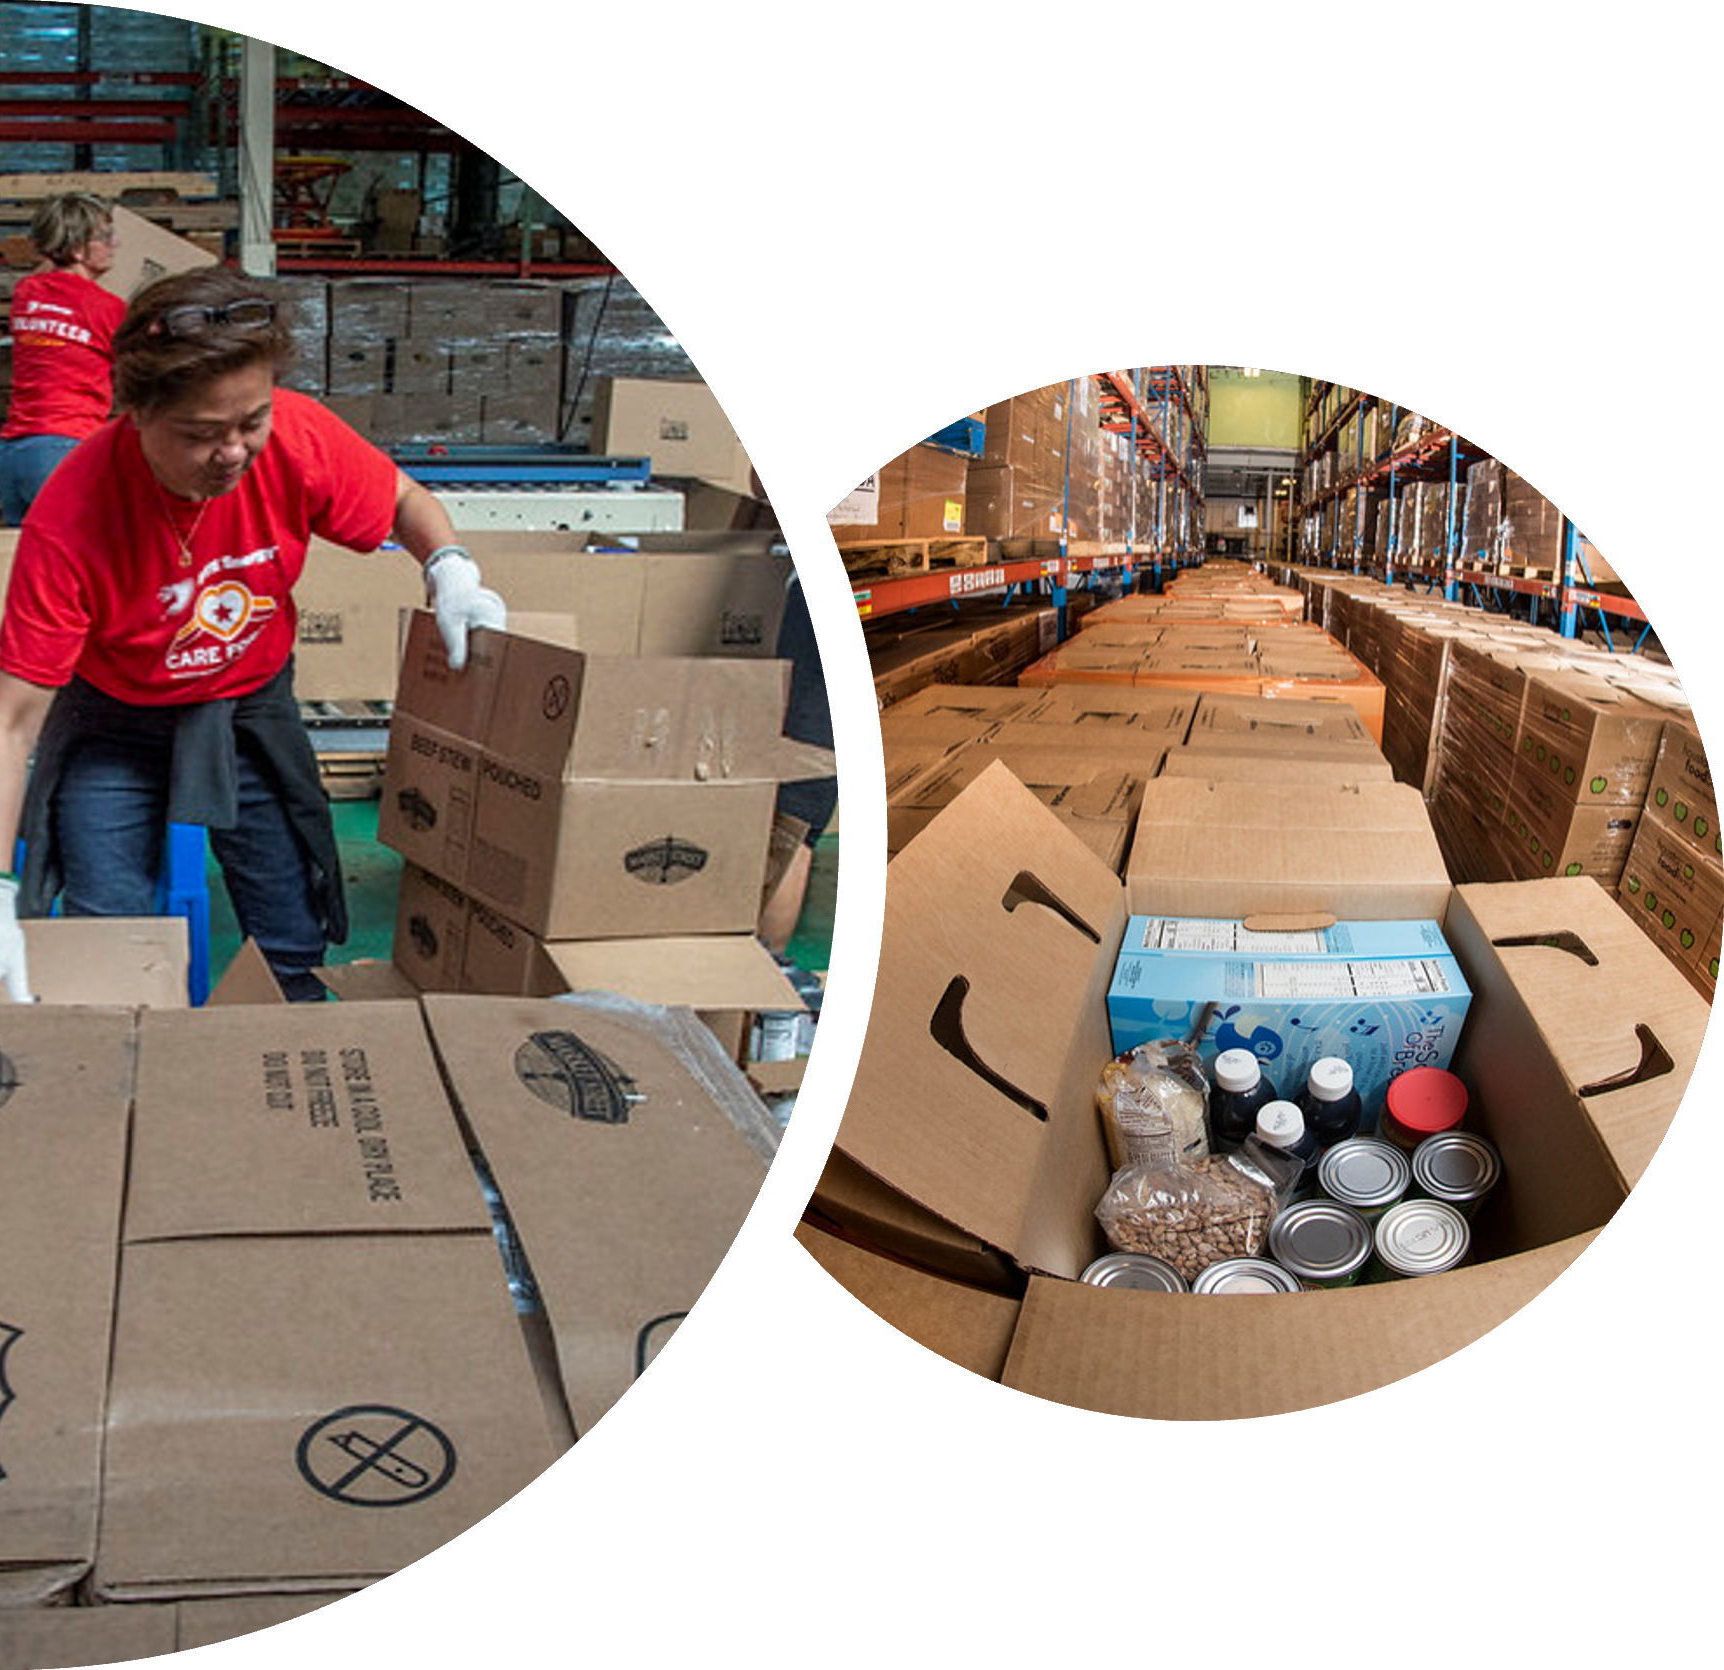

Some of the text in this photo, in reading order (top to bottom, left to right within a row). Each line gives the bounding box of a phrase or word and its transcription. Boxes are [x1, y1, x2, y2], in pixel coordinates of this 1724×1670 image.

[166, 646, 222, 669] CARE
[339, 1048, 371, 1081] STORE
[1387, 1051, 1415, 1086] Bre
